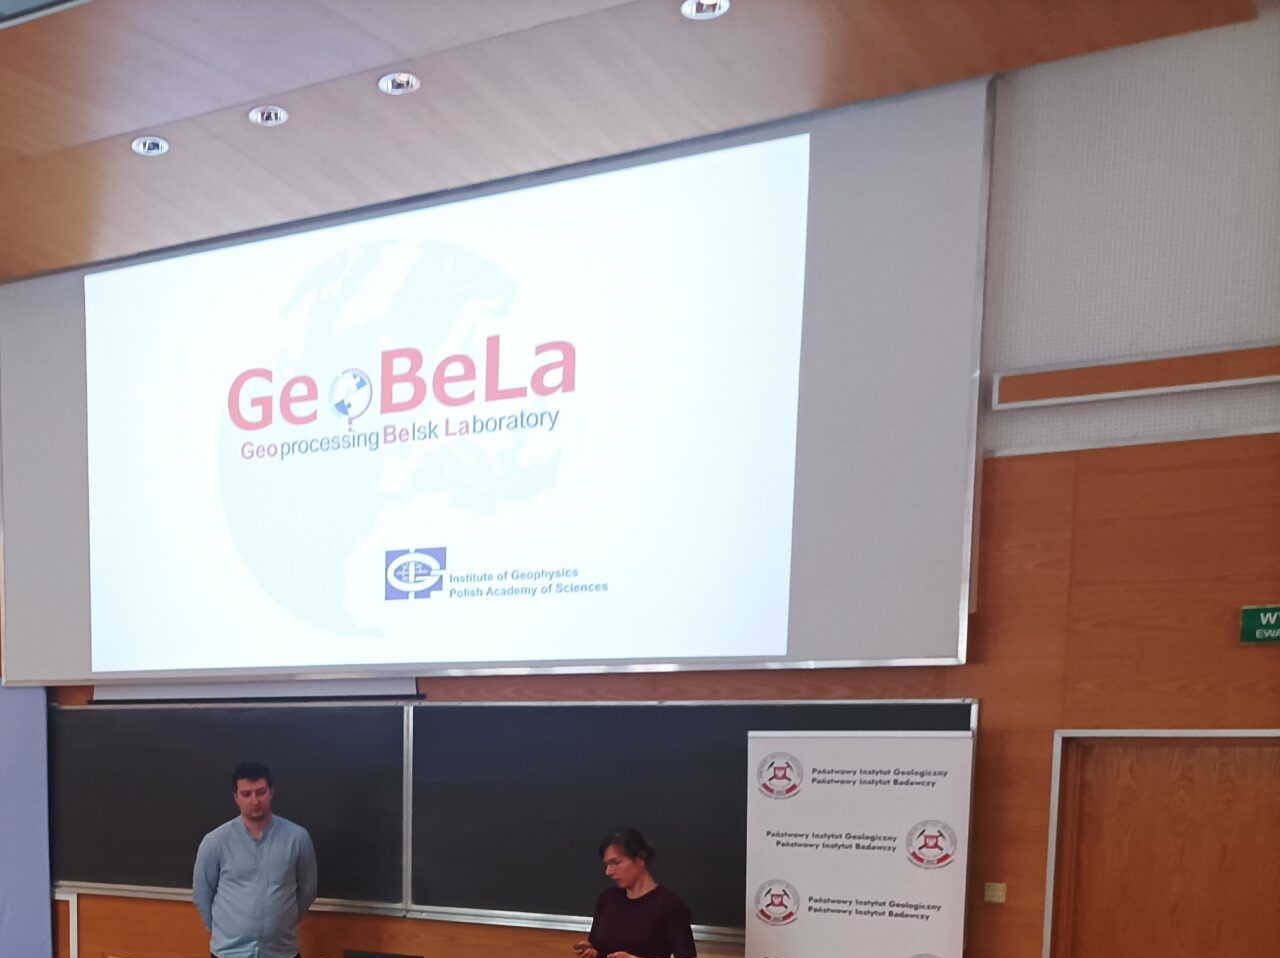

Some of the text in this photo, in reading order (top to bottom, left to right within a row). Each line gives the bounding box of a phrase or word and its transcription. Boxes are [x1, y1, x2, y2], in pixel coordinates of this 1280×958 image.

[240, 409, 561, 461] Geoprocessing Belsk Laboratory
[449, 568, 578, 584] Institute of Geophysics
[449, 582, 609, 599] Polish Academy of Sciences
[811, 768, 857, 776] Państwowy
[893, 769, 948, 777] Geologiczny
[811, 778, 857, 786] Państwowy
[893, 779, 936, 787] Badawczy
[766, 831, 897, 842] Państwowy Instytut Geologiczny
[776, 841, 896, 852] Państwowy Instytut Badawczy
[808, 896, 941, 911] Państwowy Instytut Geologiczny
[808, 906, 930, 920] Państwowy Instytut Badawczy
